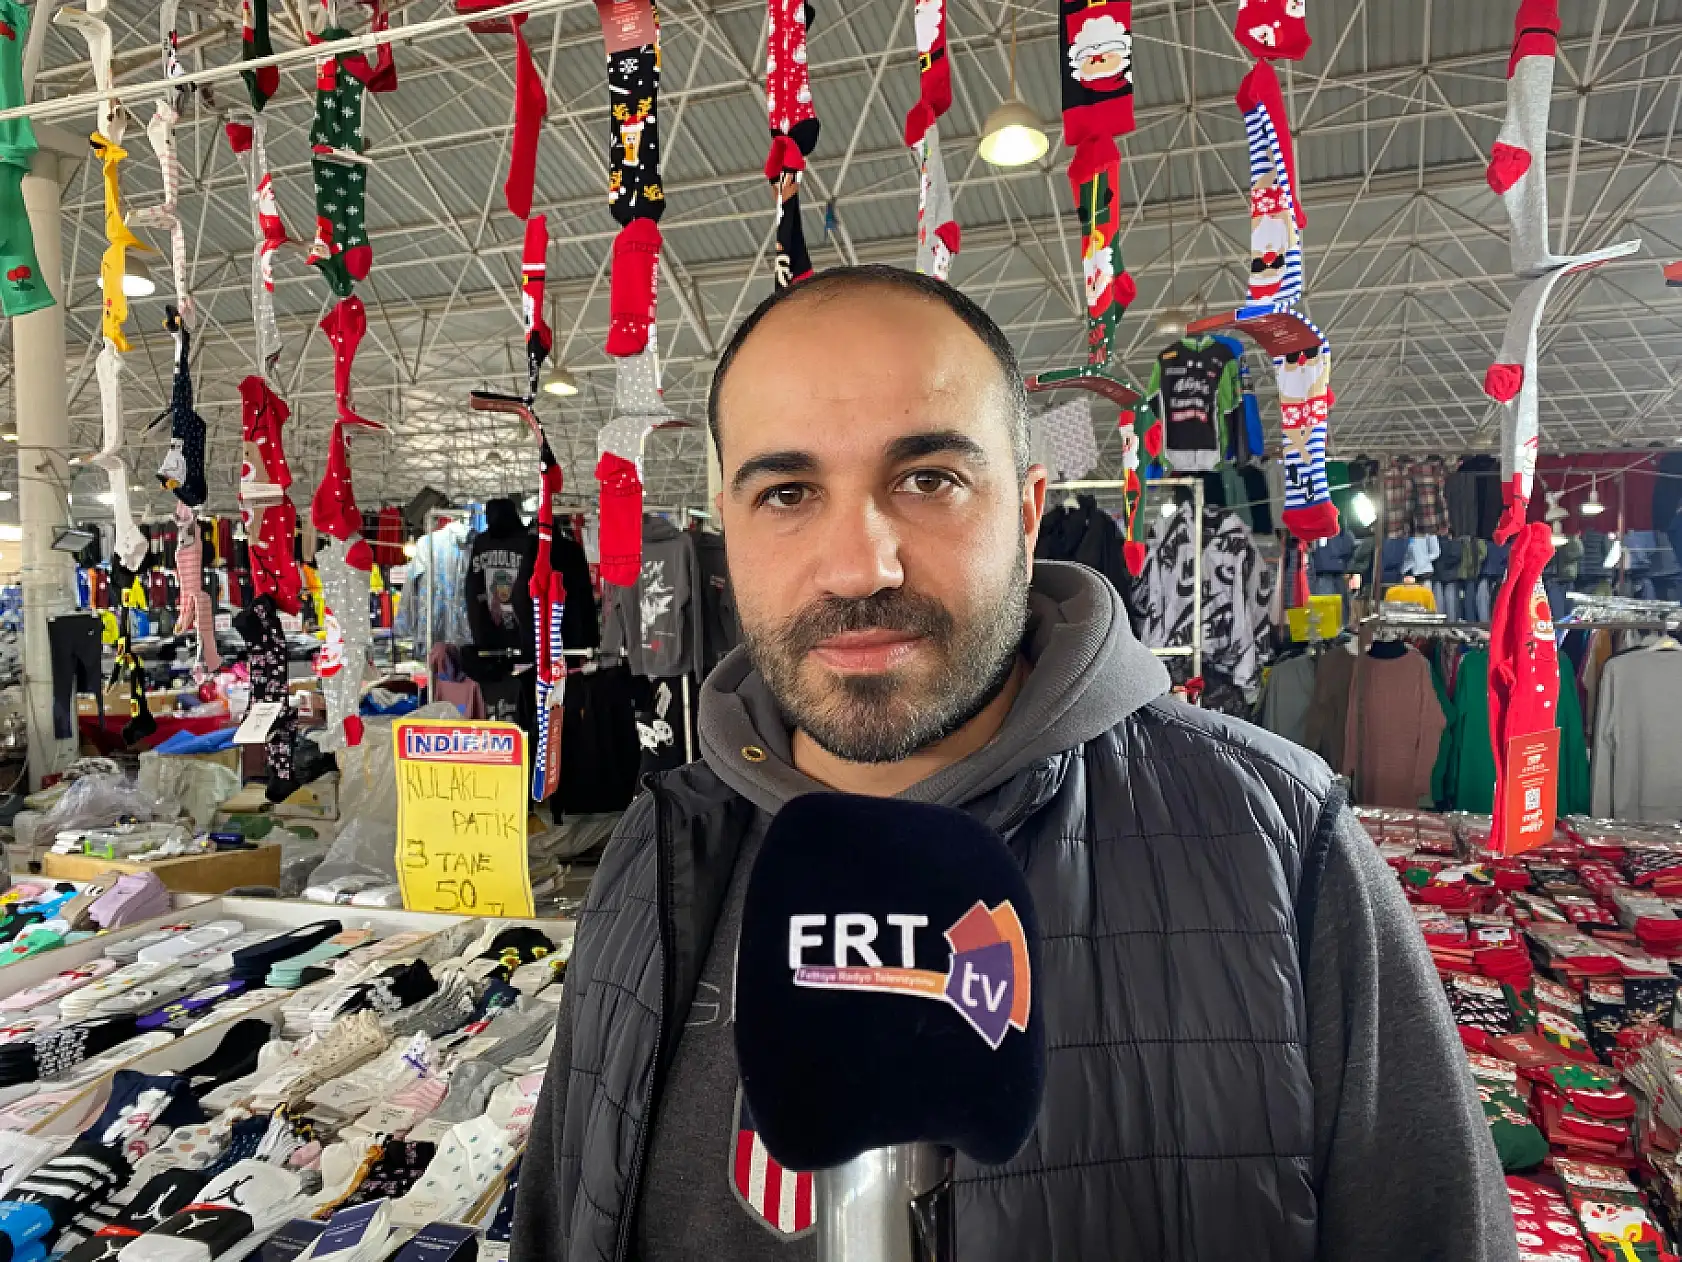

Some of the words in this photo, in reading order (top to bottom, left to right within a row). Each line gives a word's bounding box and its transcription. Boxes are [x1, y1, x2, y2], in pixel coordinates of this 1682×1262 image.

[406, 839, 428, 869] 3
[434, 852, 493, 876] TANE
[434, 879, 477, 911] 50
[789, 914, 929, 969] FRT
[961, 961, 1008, 1013] tv
